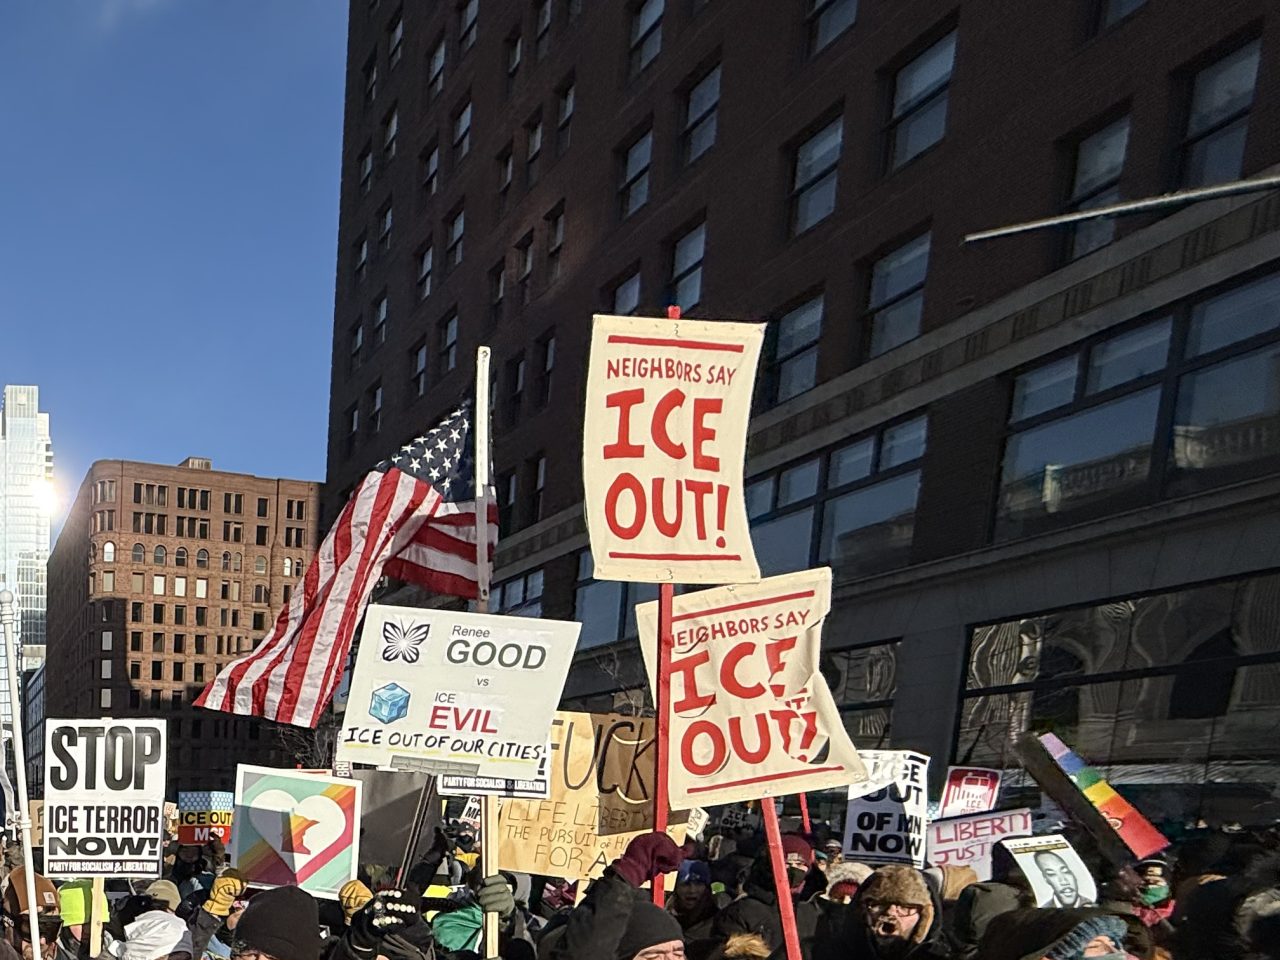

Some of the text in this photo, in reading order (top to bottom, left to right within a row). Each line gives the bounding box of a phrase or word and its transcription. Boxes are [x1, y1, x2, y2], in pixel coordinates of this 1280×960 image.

[606, 357, 736, 386] NEIGHBORS SAY
[603, 388, 723, 472] ICE
[604, 472, 730, 549] OUT!
[452, 625, 490, 638] Renee
[774, 609, 810, 630] SAY
[446, 639, 546, 670] GOOD
[476, 677, 489, 687] vs
[671, 636, 797, 713] ICE
[435, 692, 456, 704] ICE
[428, 705, 498, 734] EVIL
[344, 727, 383, 745] ICE
[388, 732, 423, 748] OUT
[425, 735, 449, 748] OF
[451, 738, 484, 755] OUR
[681, 710, 817, 775] OUT!
[50, 726, 161, 791] STOP
[49, 805, 78, 833] ICE
[83, 806, 159, 834] TERROR
[181, 812, 206, 824] ICE
[210, 812, 231, 825] OUT
[857, 811, 893, 831] OF
[936, 812, 1031, 844] LIBERTY
[49, 837, 159, 856] NOW!
[506, 824, 532, 841] THE
[540, 827, 598, 847] PURSUIT
[851, 833, 922, 856] NOW
[50, 862, 157, 873] PARTY FOR SOCIALISM & LIBERATION
[534, 844, 583, 872] FOR
